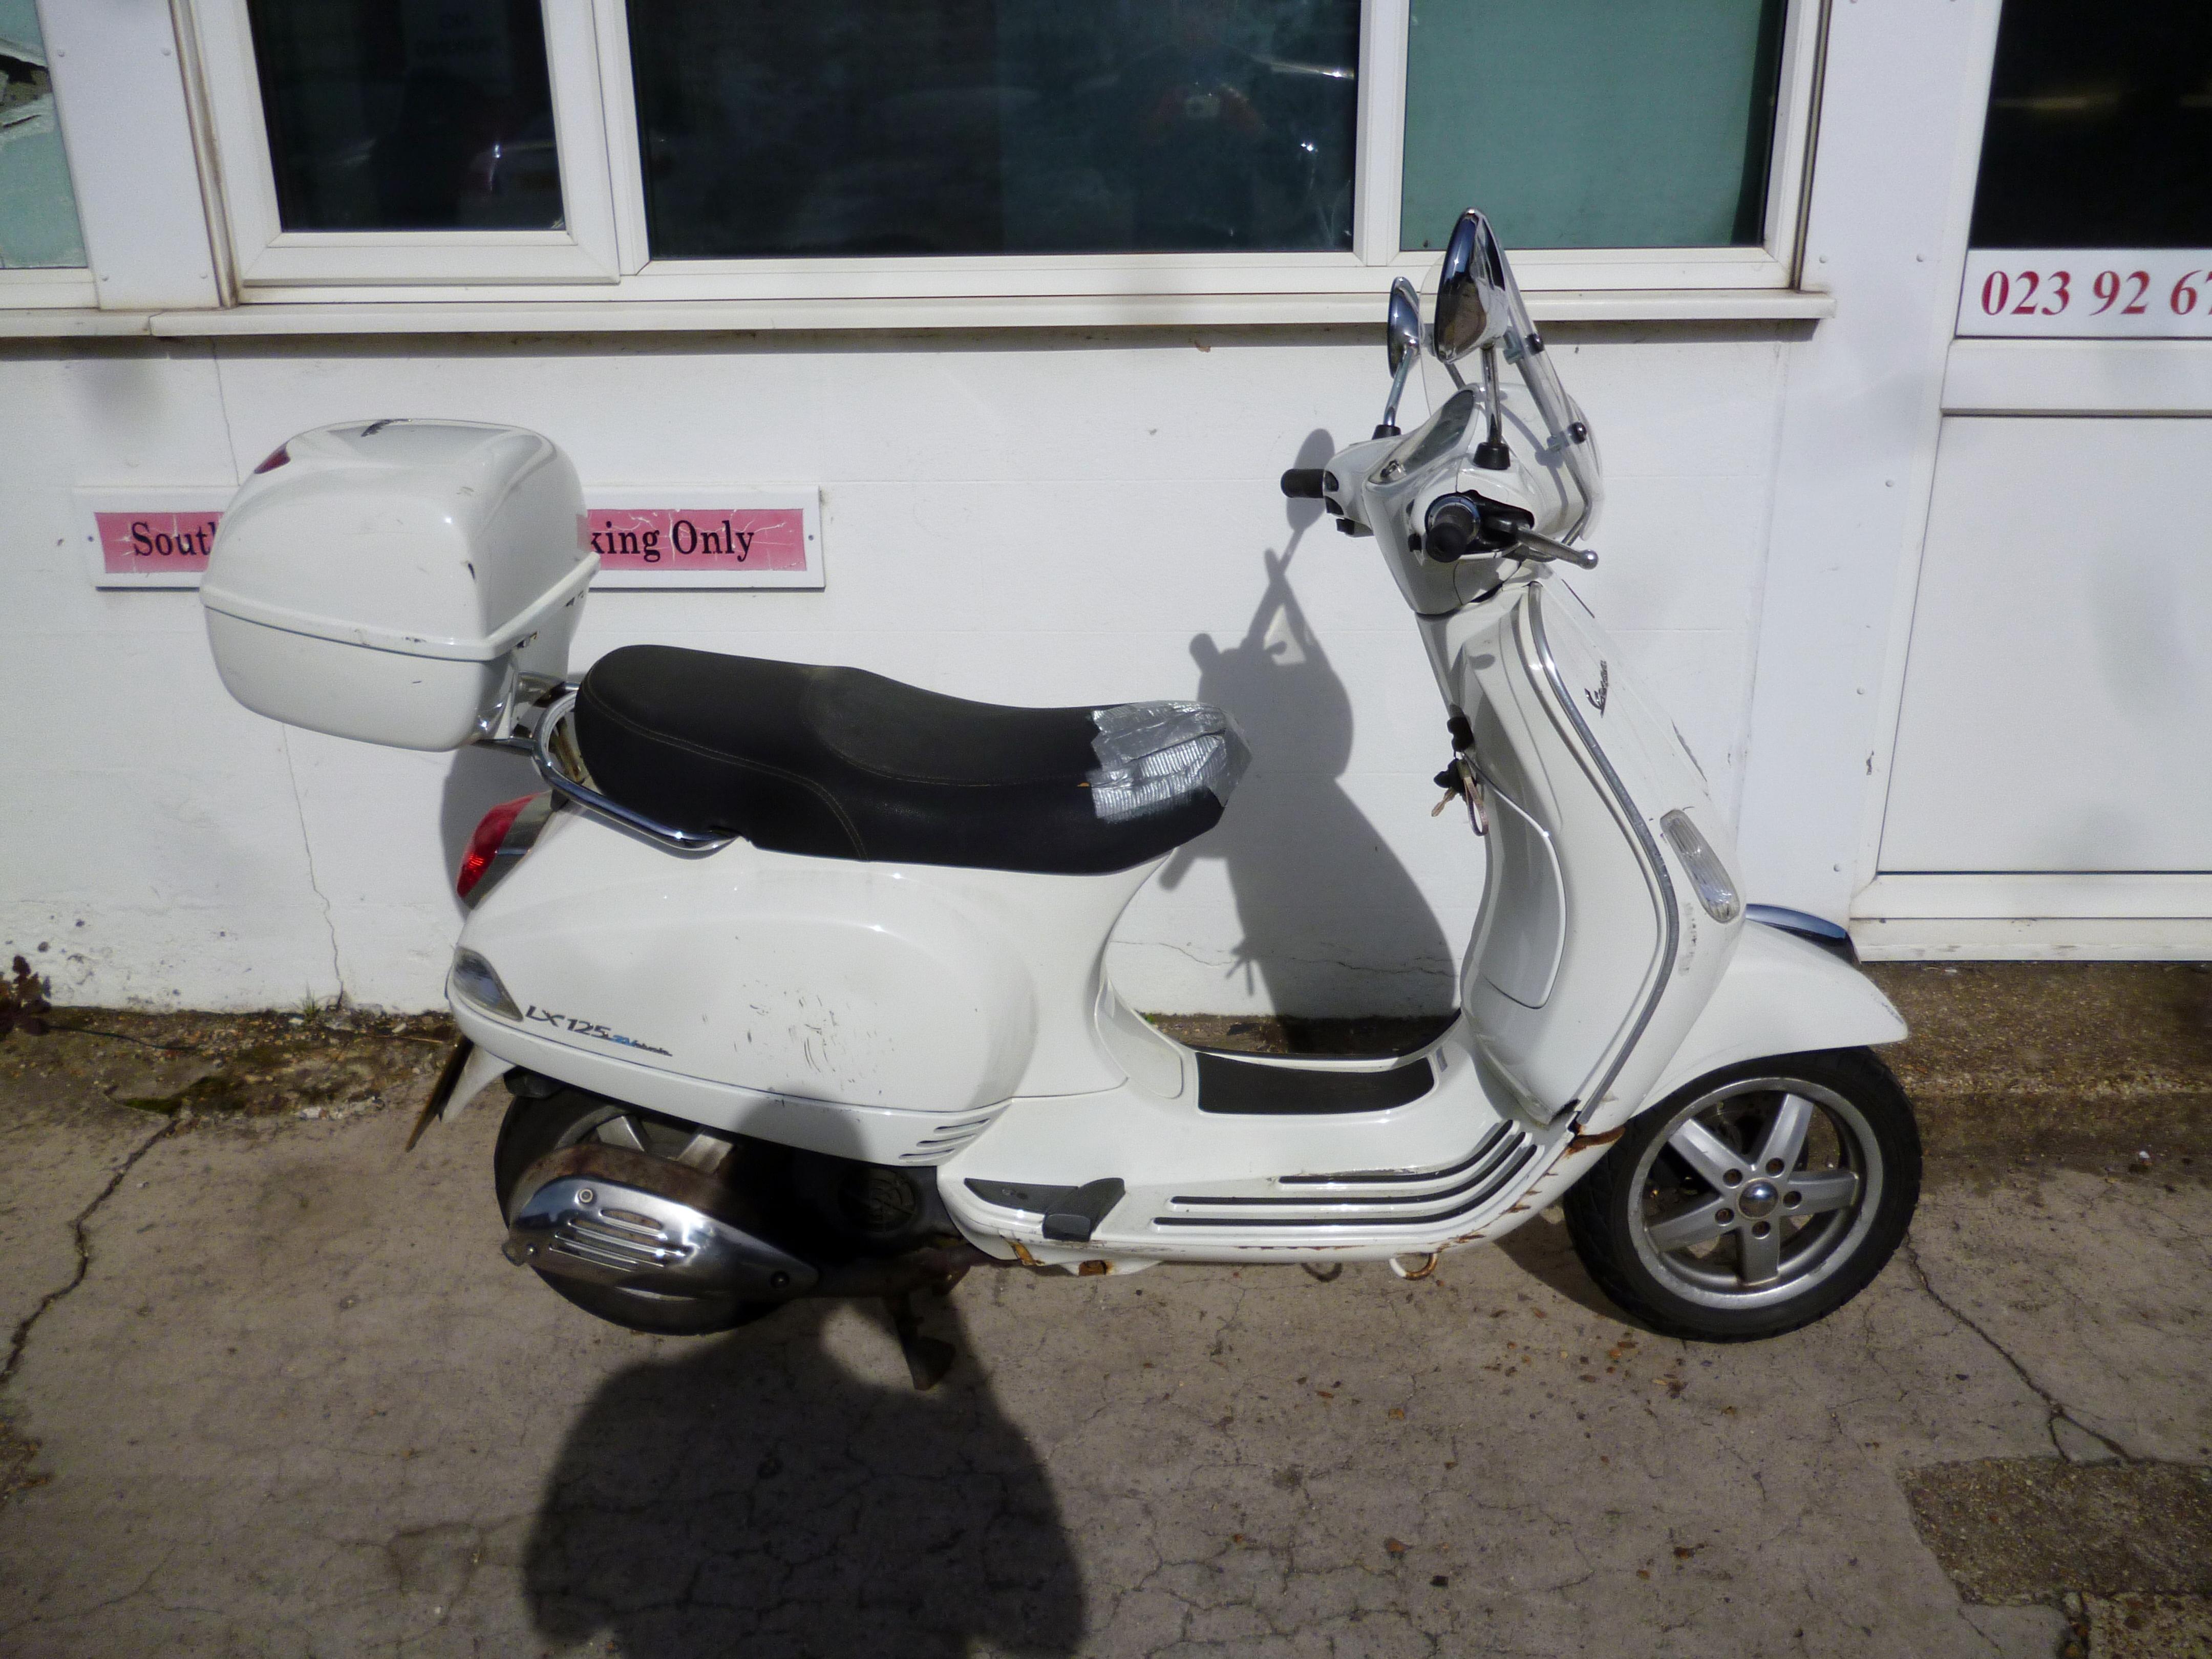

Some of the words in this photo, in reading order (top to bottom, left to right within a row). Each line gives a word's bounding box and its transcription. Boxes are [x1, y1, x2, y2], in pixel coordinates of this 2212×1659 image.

[1981, 270, 2071, 315] 023
[2089, 270, 2151, 315] 92
[672, 520, 754, 562] Only
